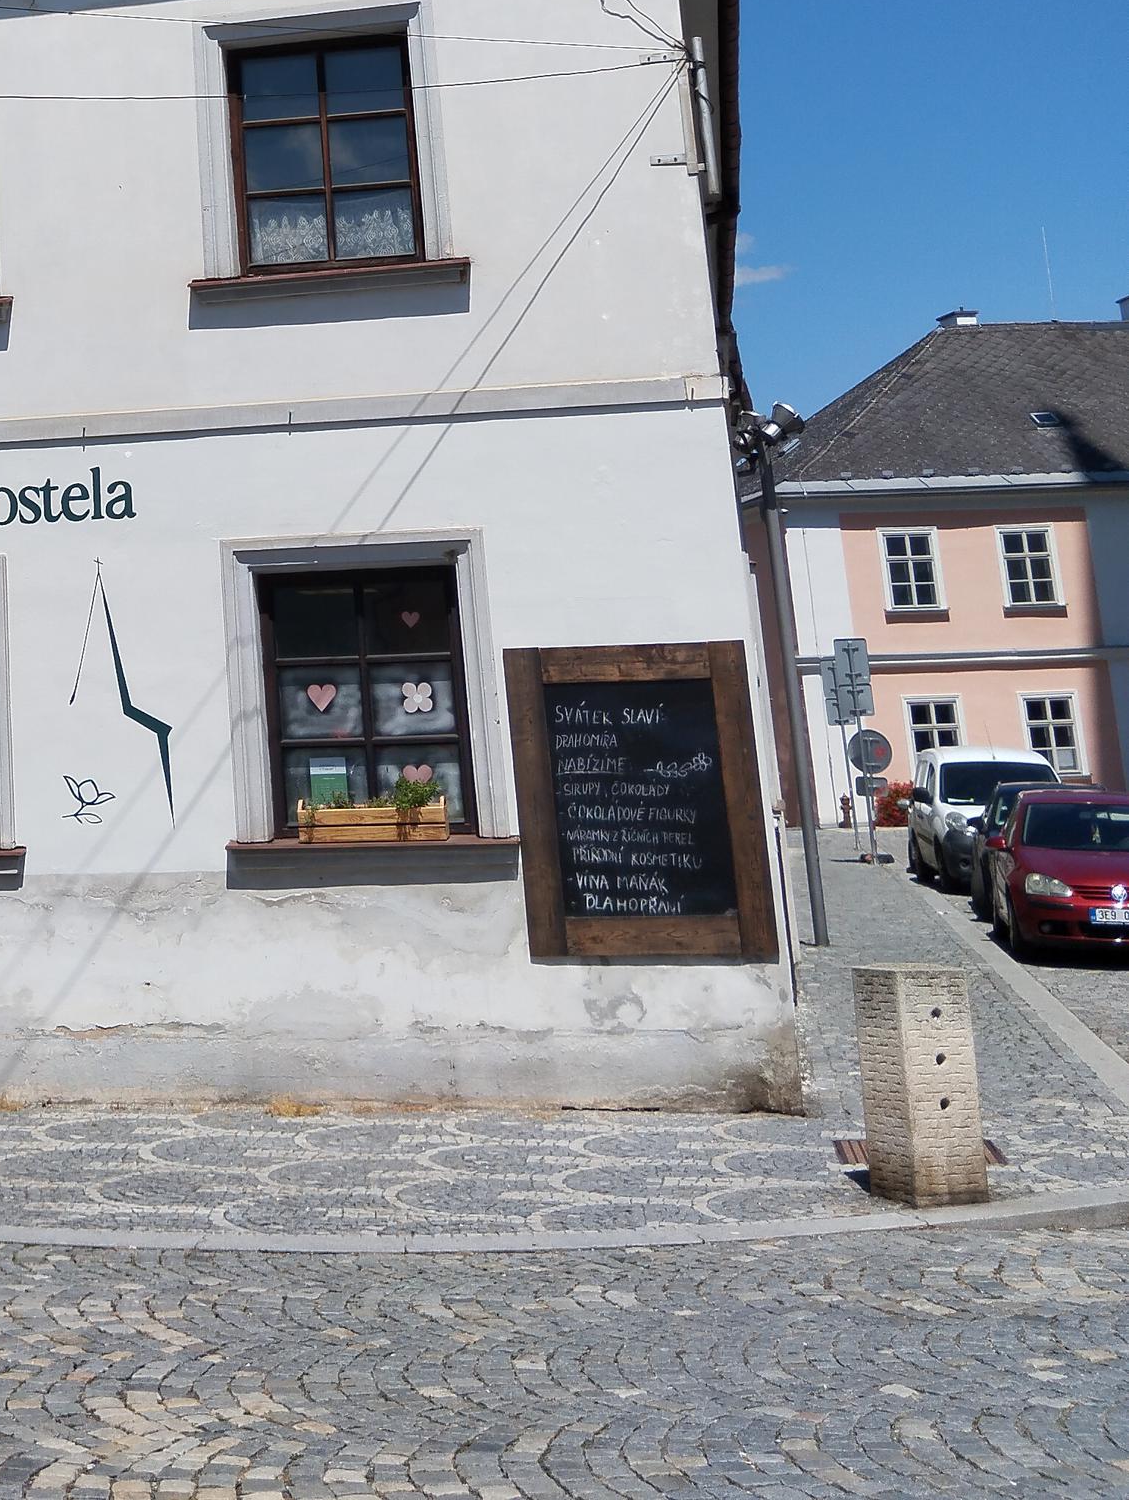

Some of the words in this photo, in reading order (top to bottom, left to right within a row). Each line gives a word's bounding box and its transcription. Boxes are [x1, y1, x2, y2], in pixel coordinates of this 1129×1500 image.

[554, 700, 613, 726] SVÁTEK
[555, 730, 619, 750] DRAHOMÍRA
[631, 852, 703, 870] KOSMETIKU
[1098, 910, 1117, 920] 3E9
